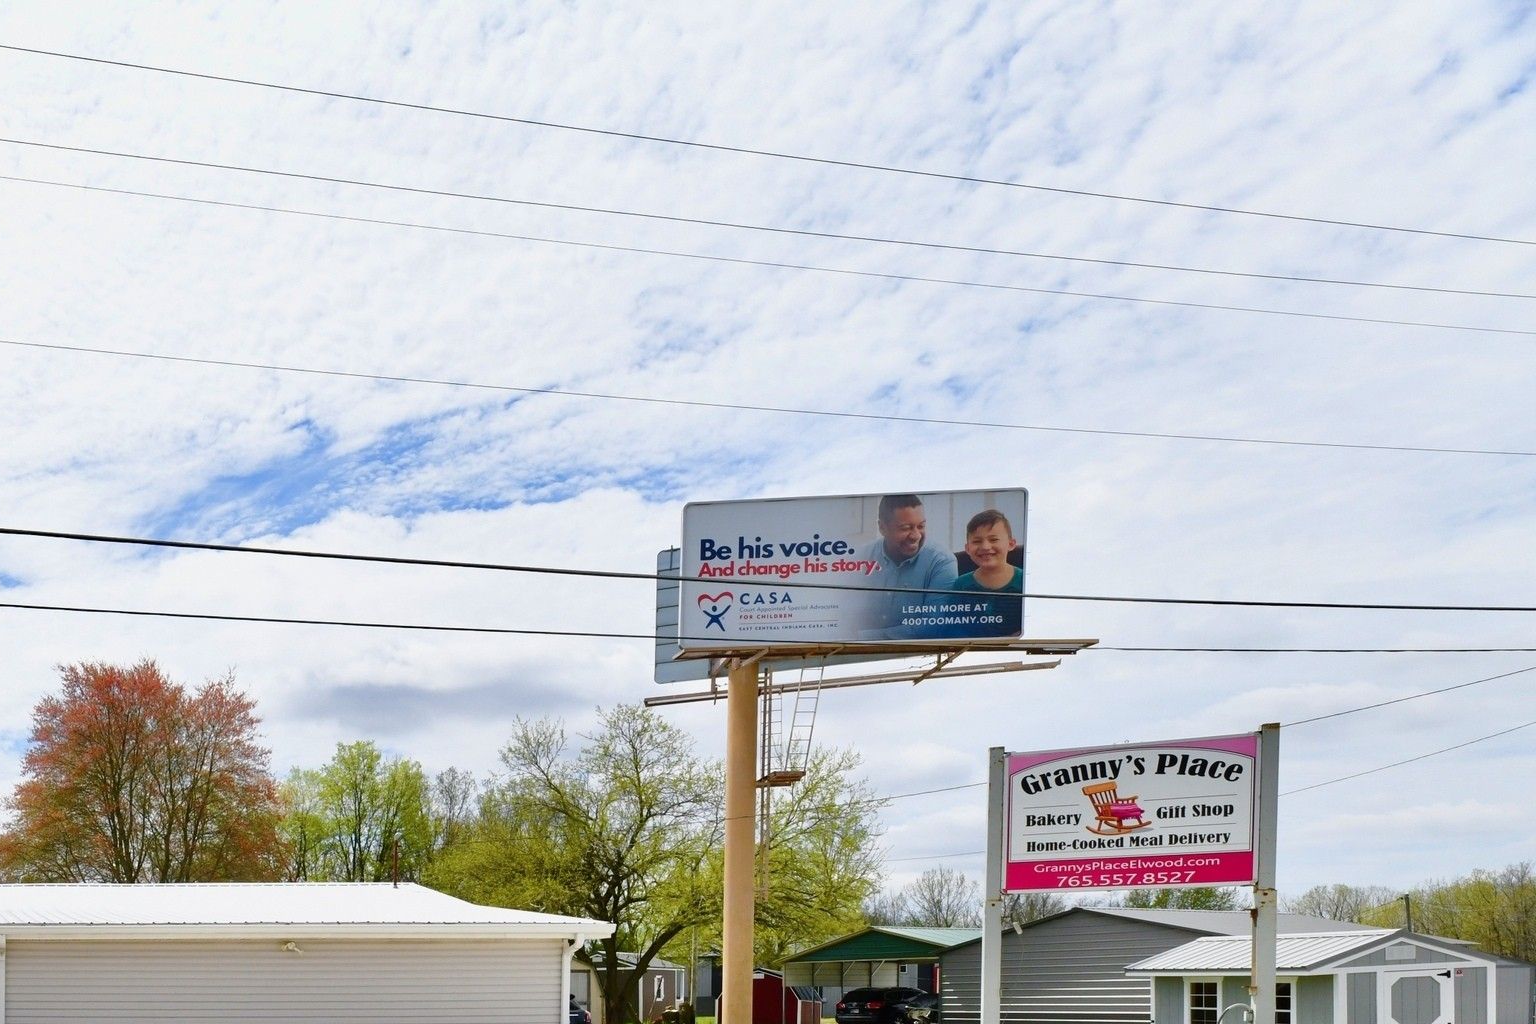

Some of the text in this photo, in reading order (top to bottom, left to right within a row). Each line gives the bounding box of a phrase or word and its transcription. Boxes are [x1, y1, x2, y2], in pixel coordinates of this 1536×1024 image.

[700, 534, 855, 561] Be his voice.
[698, 557, 881, 579] And change his story.
[739, 592, 793, 605] CASA
[901, 603, 988, 614] LEARN MORE AT
[901, 615, 1003, 626] 400TOOMANY.ORG
[1020, 753, 1244, 795] Granny's Place
[1025, 812, 1082, 828] Bakery
[1156, 803, 1235, 820] Gift Shop
[1026, 831, 1231, 853] Home-Cooked Meal Delivery
[1033, 856, 1221, 875] GrannysPlaceElwood.com
[1056, 871, 1196, 888] 765.557.8527
